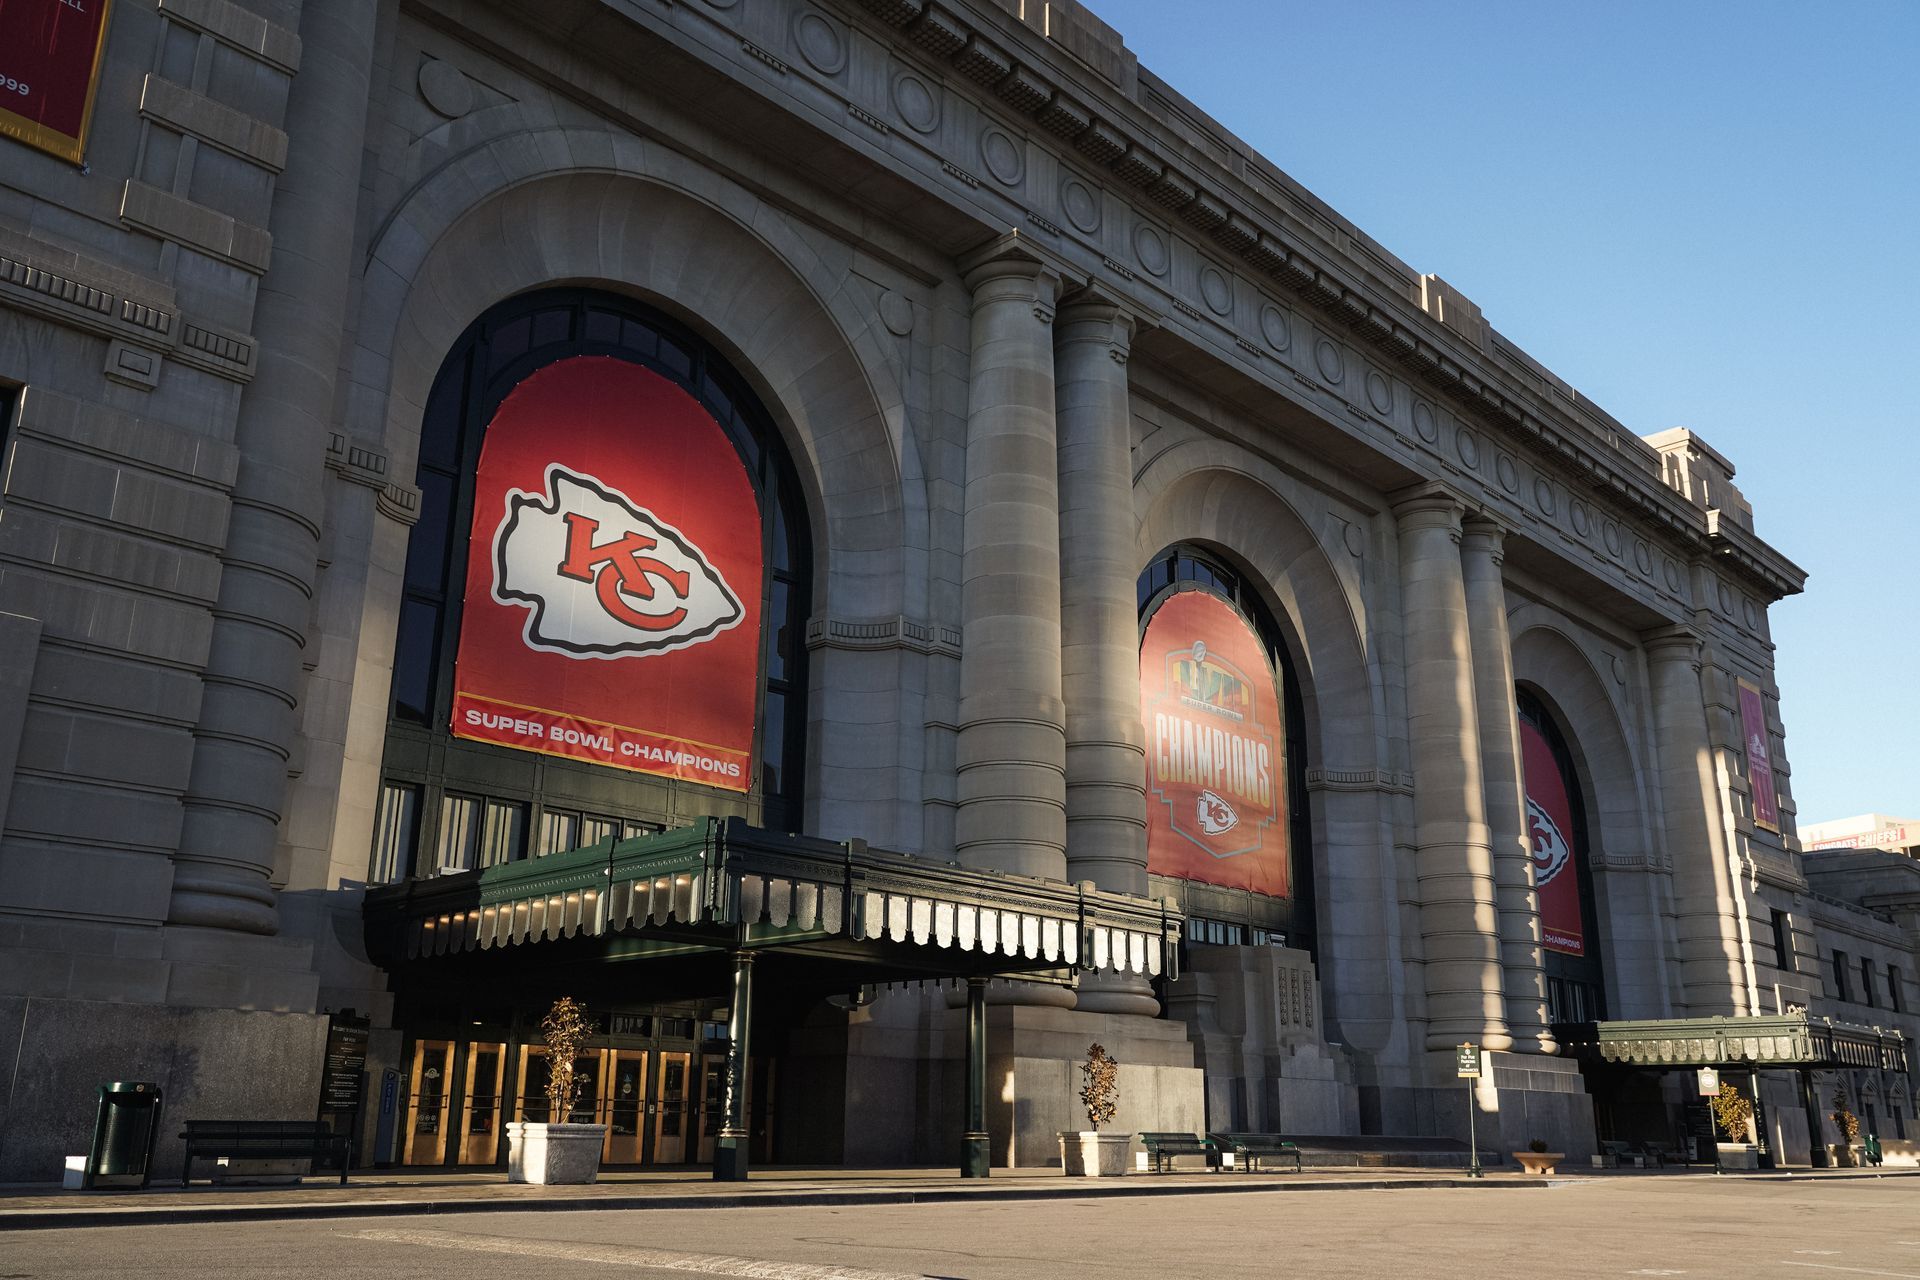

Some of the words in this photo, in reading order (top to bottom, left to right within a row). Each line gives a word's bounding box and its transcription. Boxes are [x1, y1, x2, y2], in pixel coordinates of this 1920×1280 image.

[557, 512, 690, 632] KC
[465, 709, 544, 738] SUPER
[550, 726, 615, 753] BOWL
[620, 741, 740, 777] CHAMPIONS
[1156, 713, 1270, 809] CHAMPIONS
[1206, 800, 1229, 827] KC
[1545, 934, 1581, 949] CHAMPIONS
